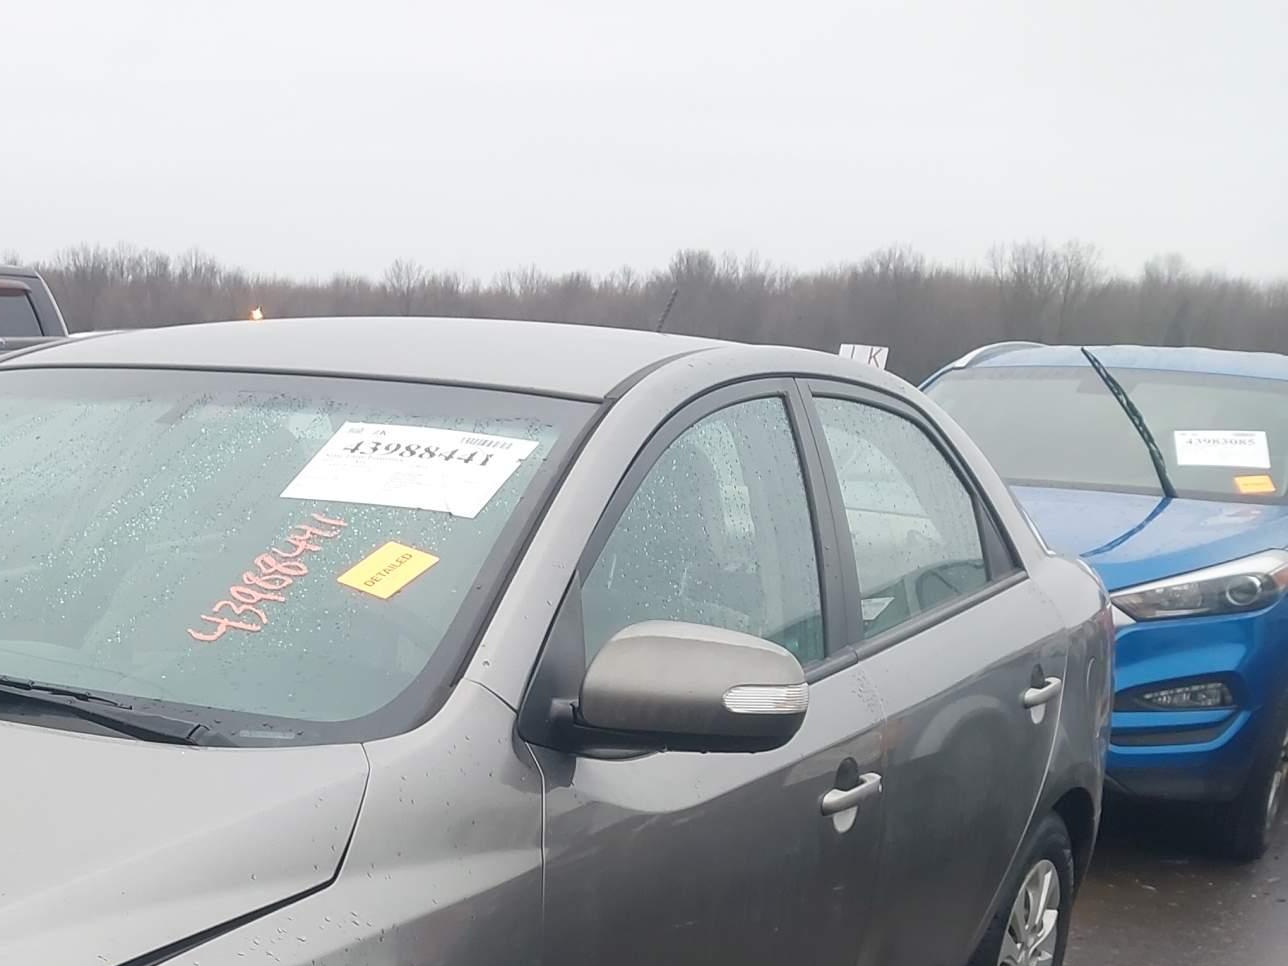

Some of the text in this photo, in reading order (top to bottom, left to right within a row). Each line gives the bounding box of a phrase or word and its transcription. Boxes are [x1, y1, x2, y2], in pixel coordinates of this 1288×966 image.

[344, 440, 494, 467] 43988441
[186, 511, 349, 642] 43988441
[363, 551, 414, 588] DETAILED
